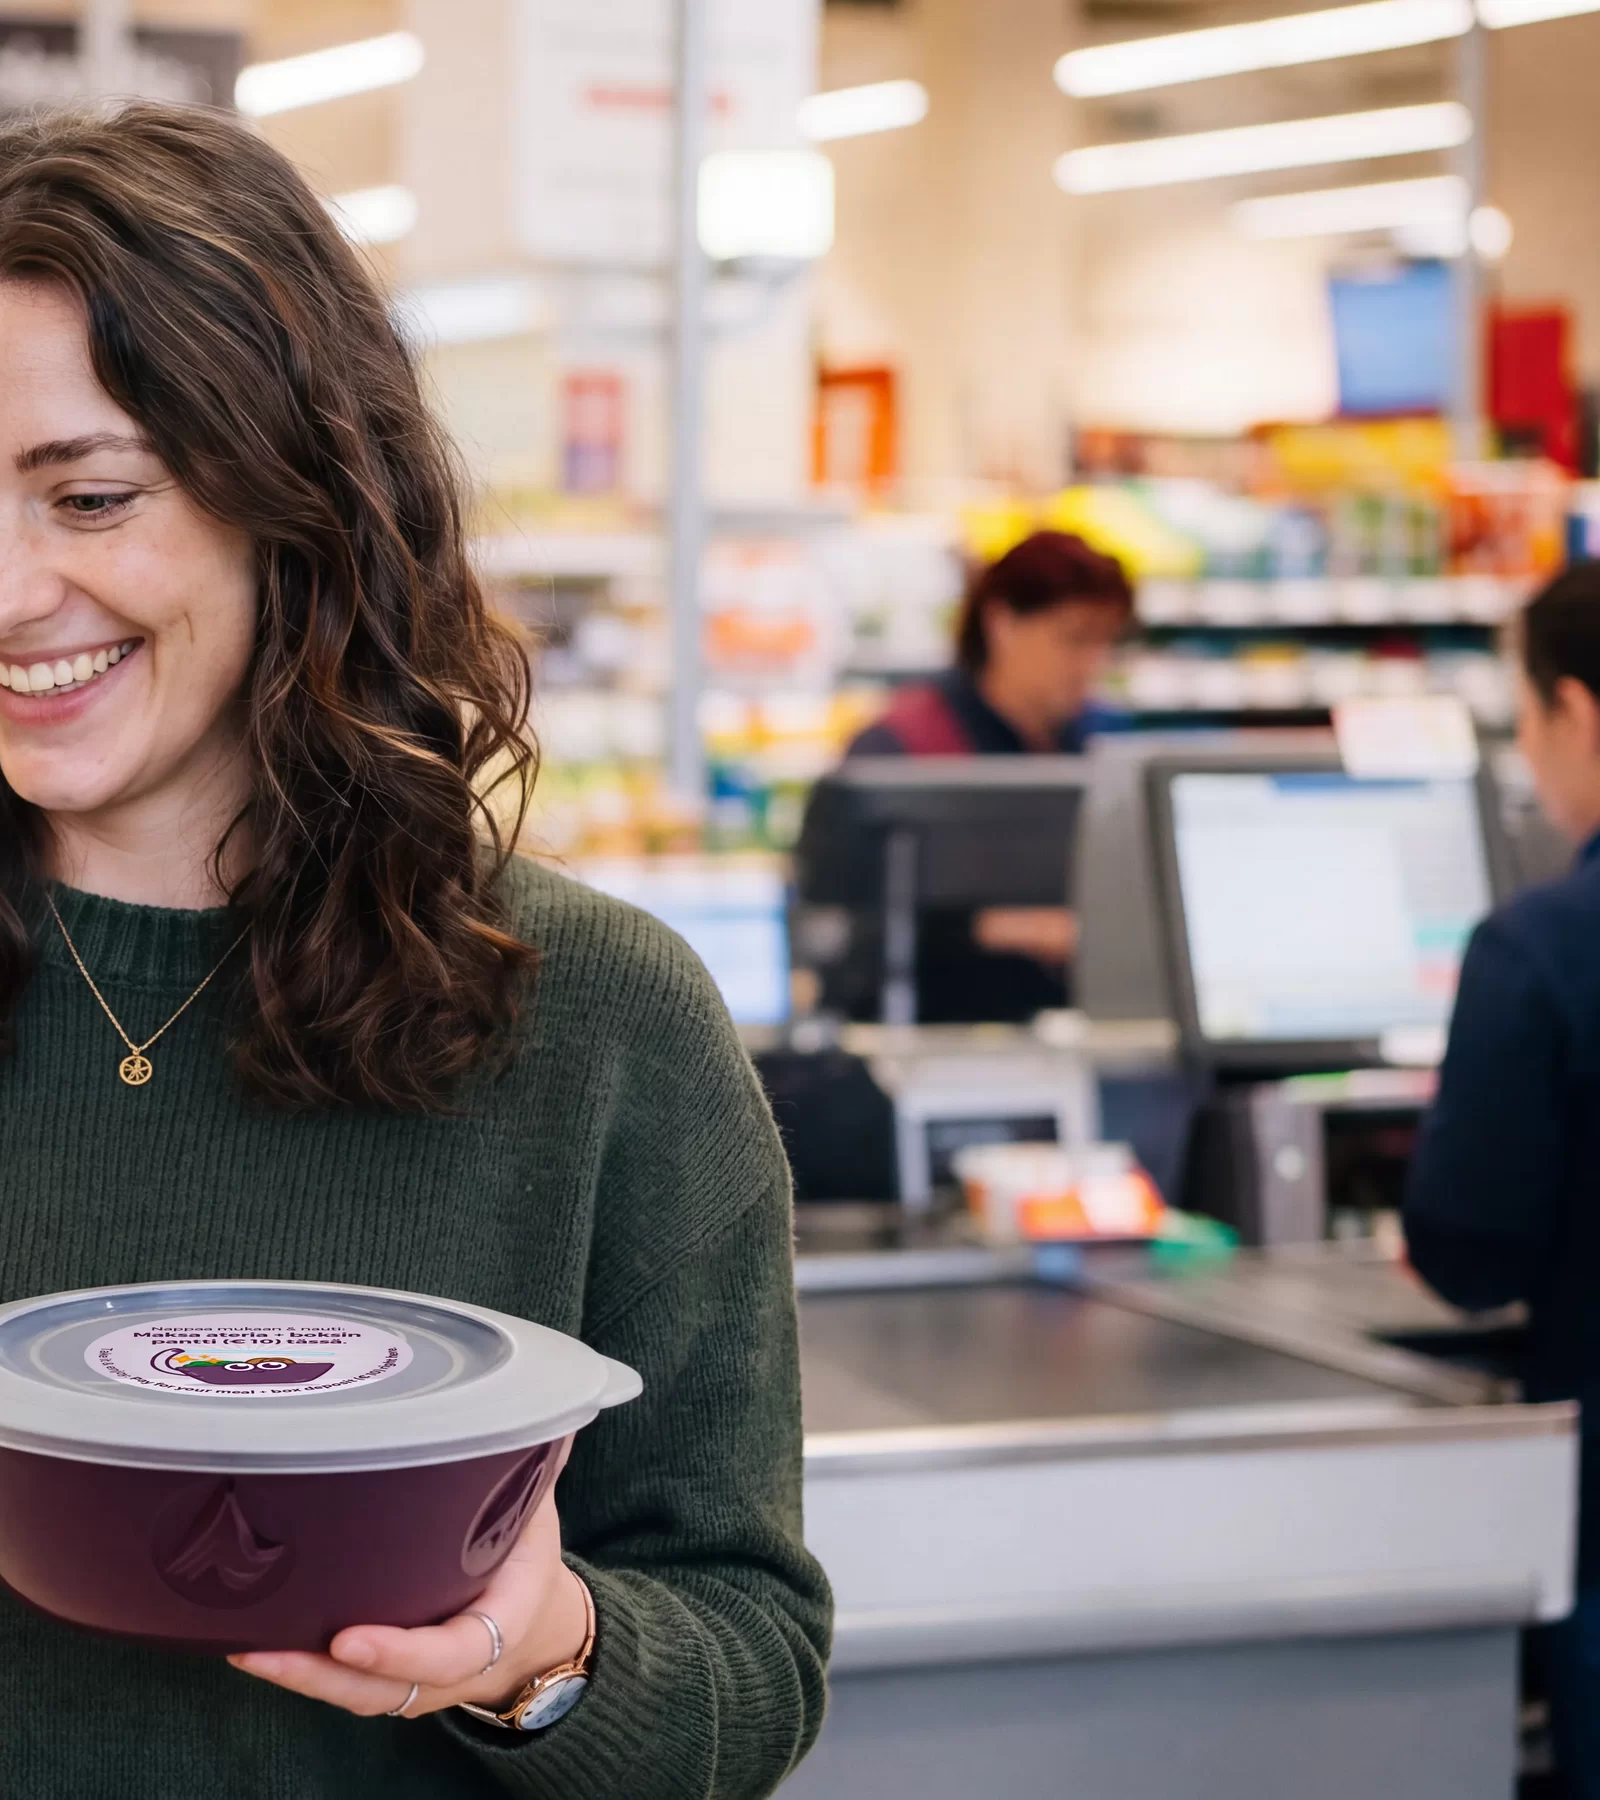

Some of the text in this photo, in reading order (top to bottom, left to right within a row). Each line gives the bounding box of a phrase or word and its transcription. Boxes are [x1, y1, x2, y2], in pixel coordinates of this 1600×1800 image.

[130, 1376, 153, 1385] Pay
[173, 1385, 213, 1393] your
[304, 1379, 357, 1390] deposit
